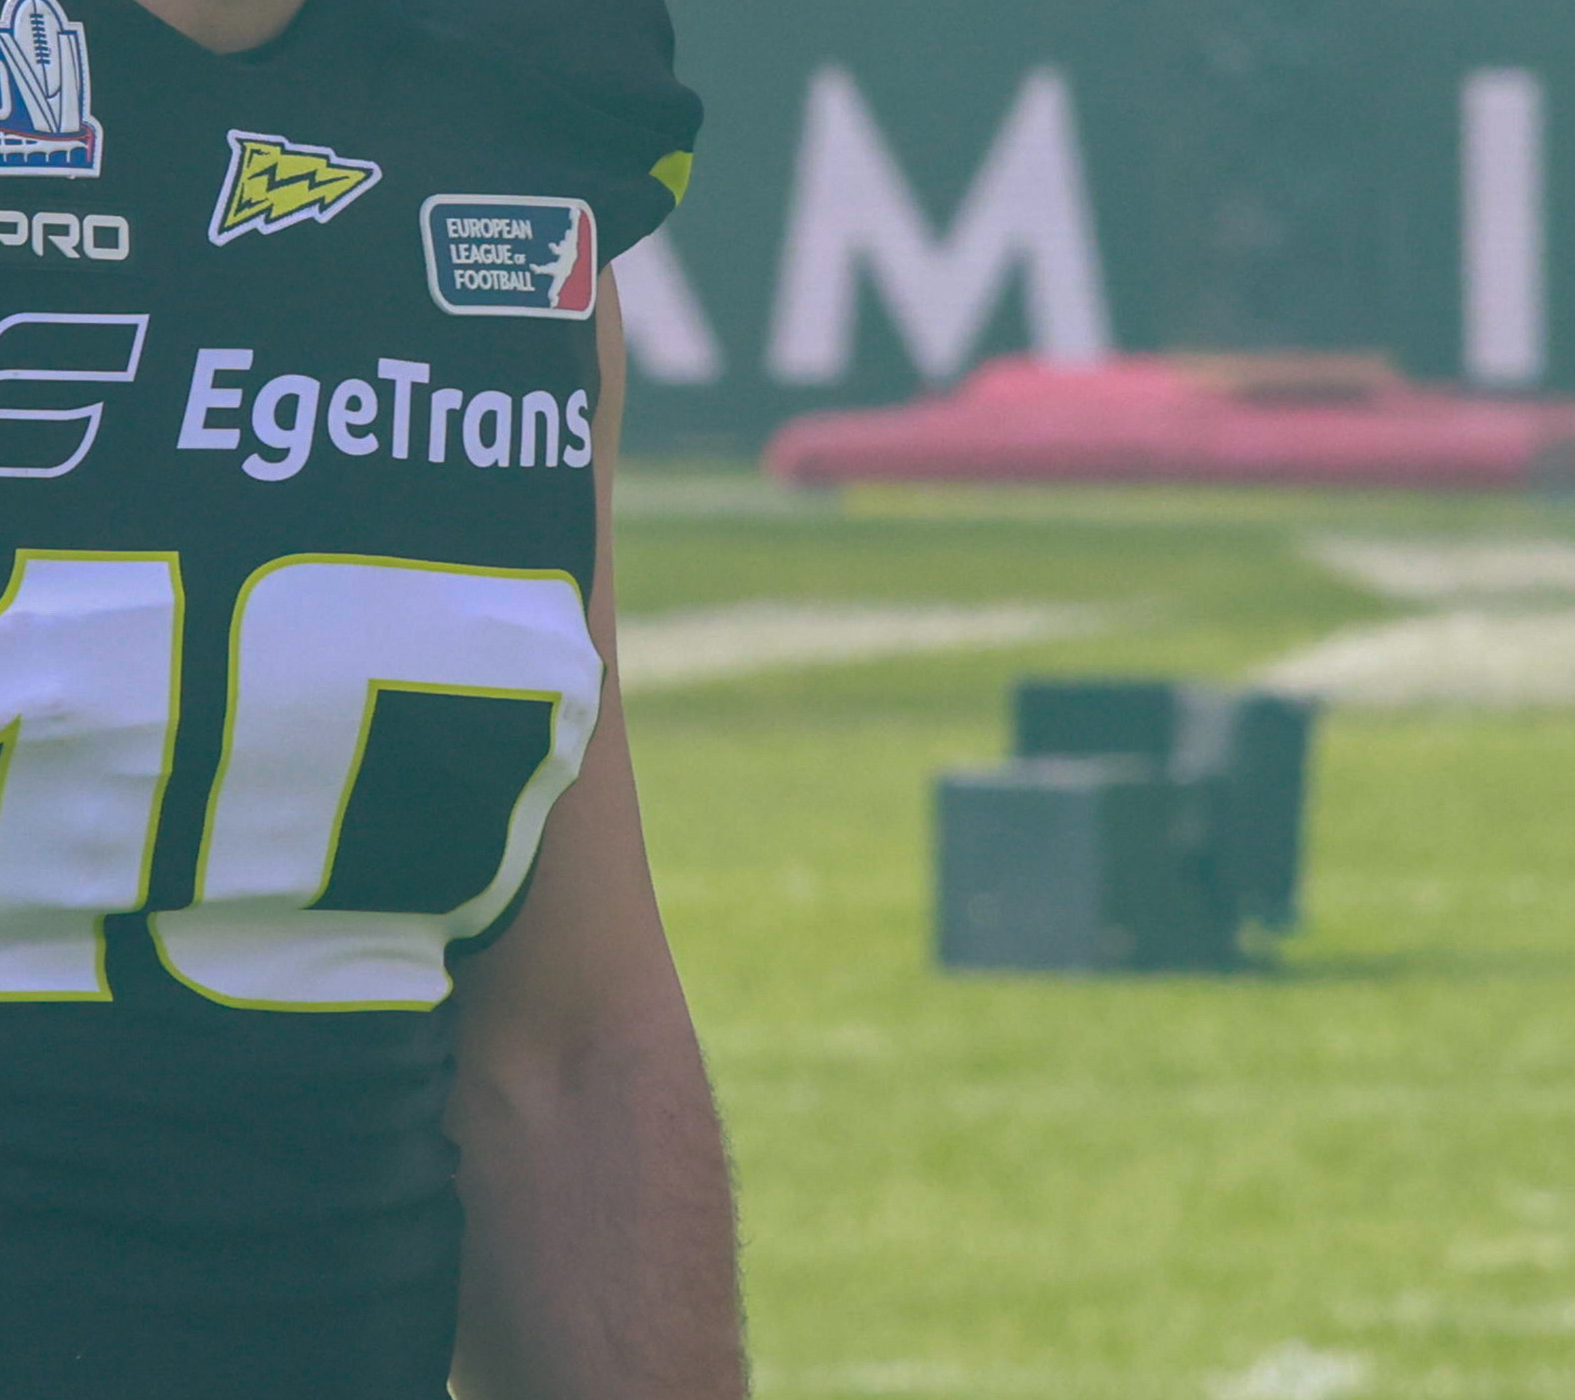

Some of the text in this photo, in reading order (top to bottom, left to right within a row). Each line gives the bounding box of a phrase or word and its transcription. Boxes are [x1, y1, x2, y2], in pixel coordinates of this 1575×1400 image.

[446, 218, 533, 239] EUROPEAN
[449, 243, 513, 264] LEAGUE
[454, 270, 535, 291] FOOTBALL
[176, 347, 593, 482] EgeTrans
